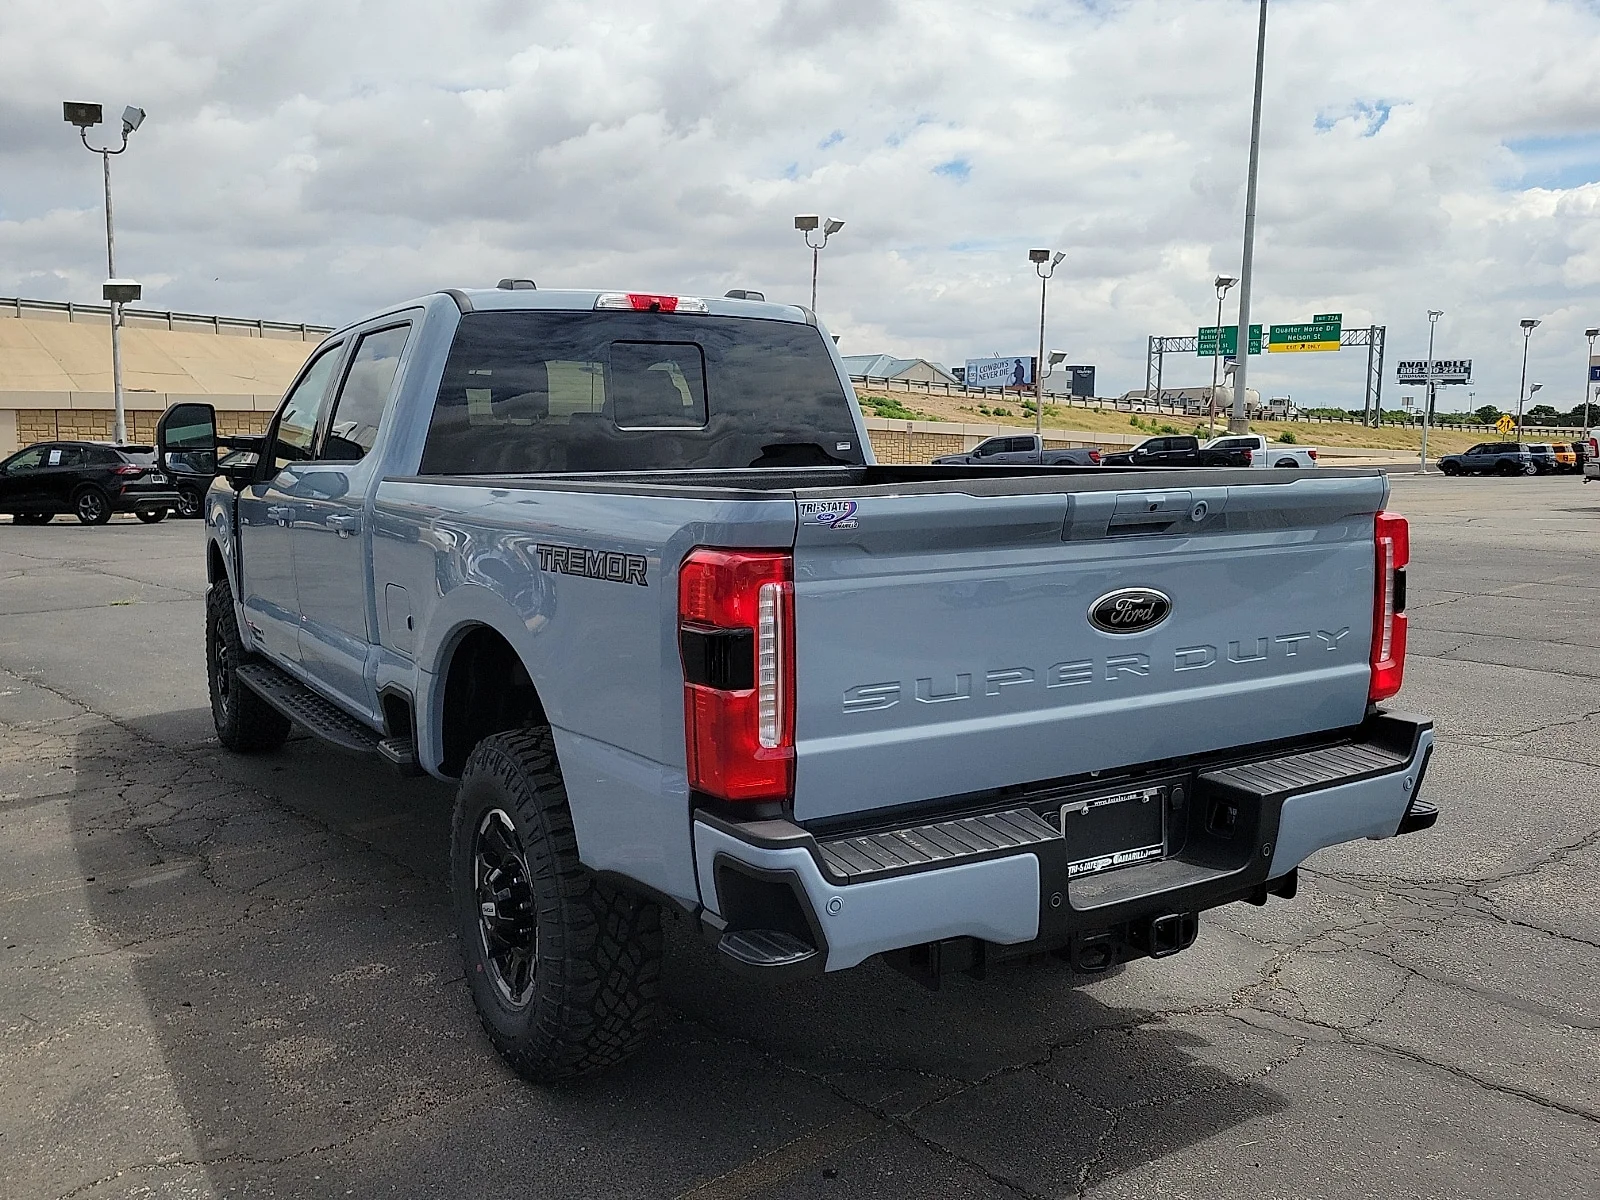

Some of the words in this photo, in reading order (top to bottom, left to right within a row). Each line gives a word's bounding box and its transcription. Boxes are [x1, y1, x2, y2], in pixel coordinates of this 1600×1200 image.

[1275, 326, 1300, 334] Quarter
[1303, 325, 1323, 333] Horse
[1287, 333, 1311, 341] Nelson
[979, 359, 1009, 374] COWBOYS
[979, 371, 999, 381] NEVER
[999, 368, 1010, 377] DIE
[799, 501, 849, 516] TRI-STATE
[536, 543, 649, 587] TREMOR
[1110, 597, 1155, 624] Ford
[842, 652, 1150, 714] SUPER
[1173, 626, 1350, 673] DUTY
